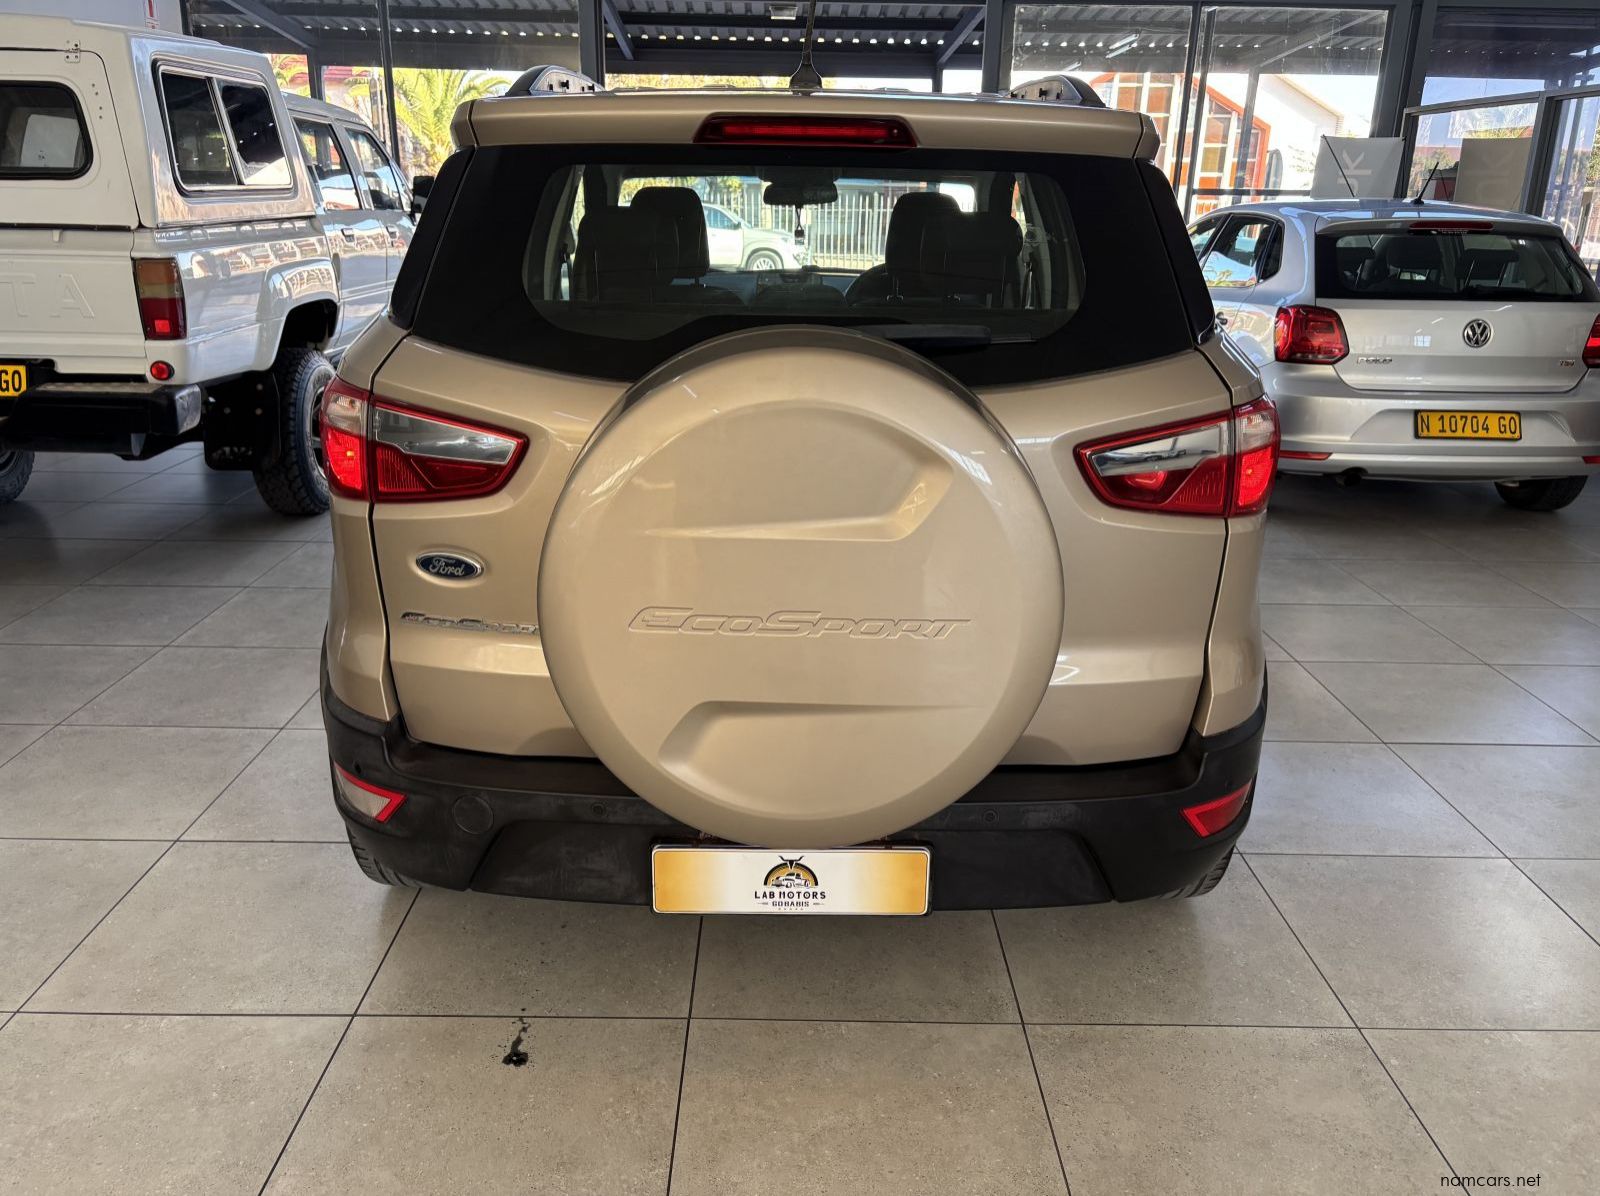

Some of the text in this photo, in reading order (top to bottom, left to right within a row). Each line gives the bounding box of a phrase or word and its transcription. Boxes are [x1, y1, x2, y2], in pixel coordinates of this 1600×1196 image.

[1420, 414, 1518, 435] N 10704 GO
[754, 891, 826, 900] LAB MOTORS
